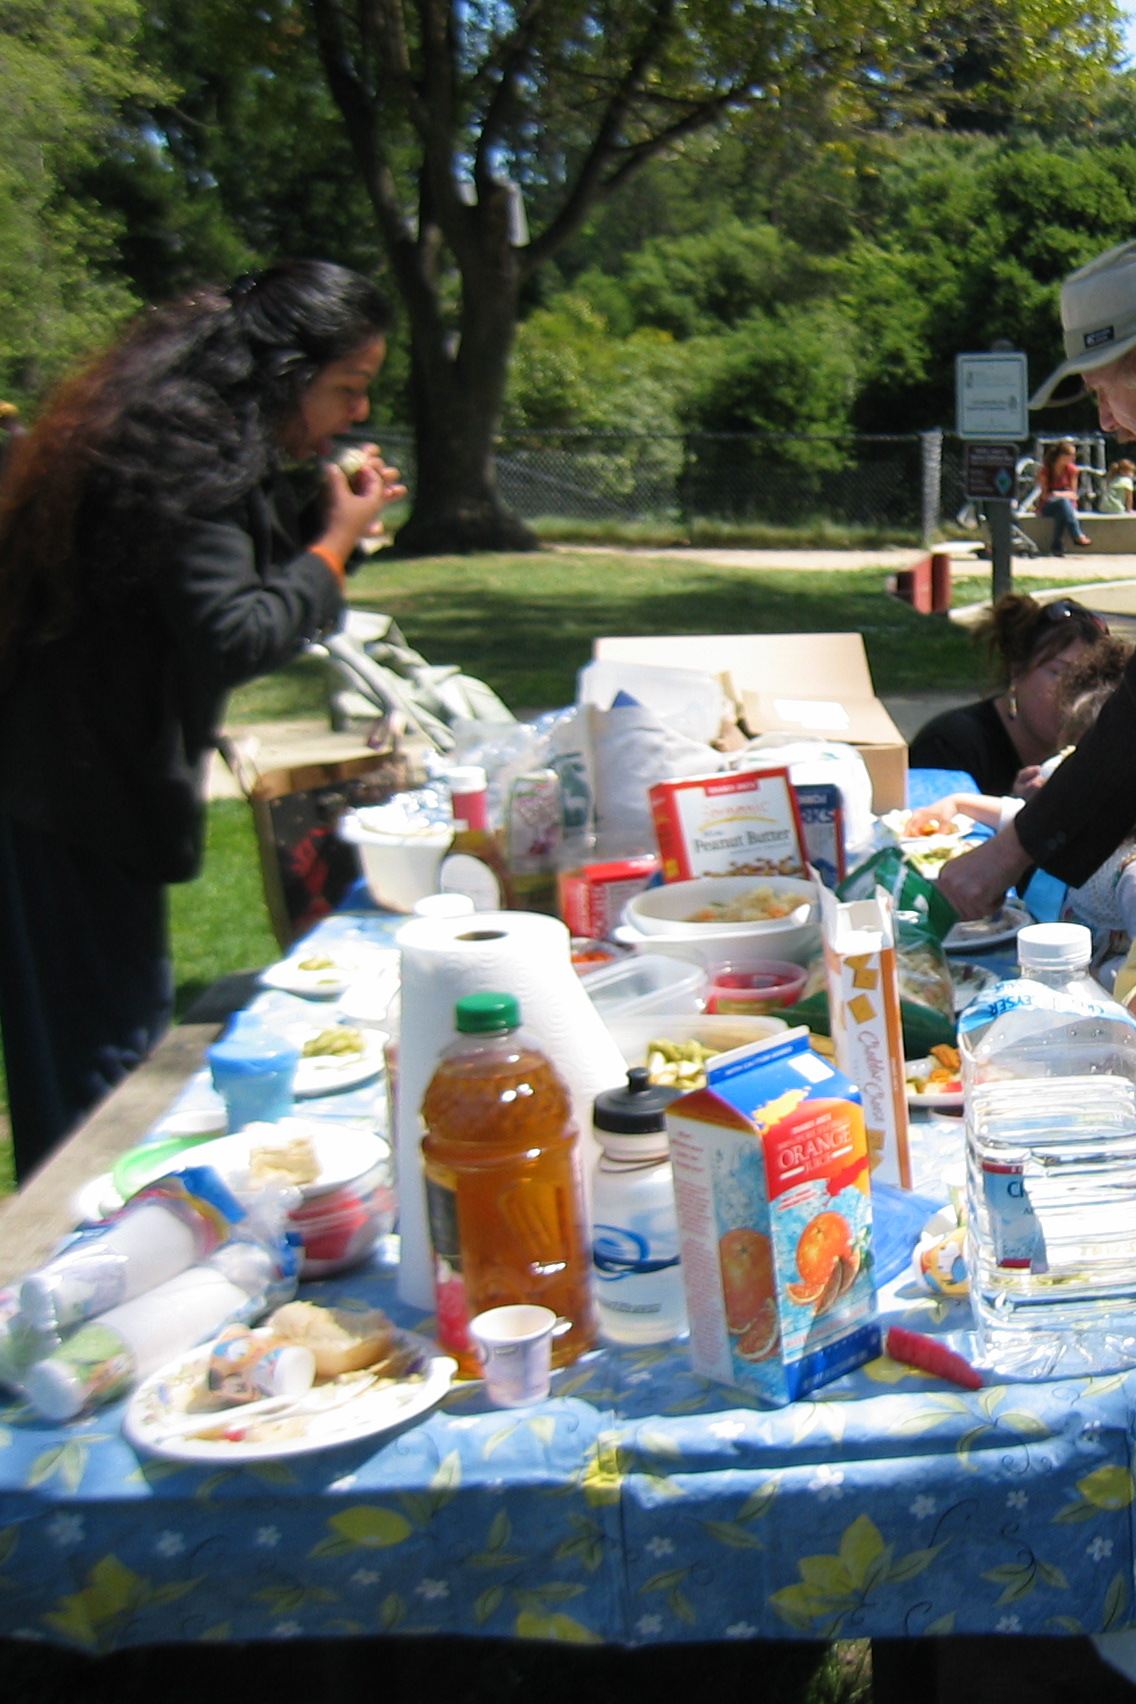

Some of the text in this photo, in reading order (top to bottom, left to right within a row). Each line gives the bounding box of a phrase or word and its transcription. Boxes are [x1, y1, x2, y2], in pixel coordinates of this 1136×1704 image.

[694, 828, 790, 853] Peanut Butter
[779, 1123, 852, 1168] ORANGE
